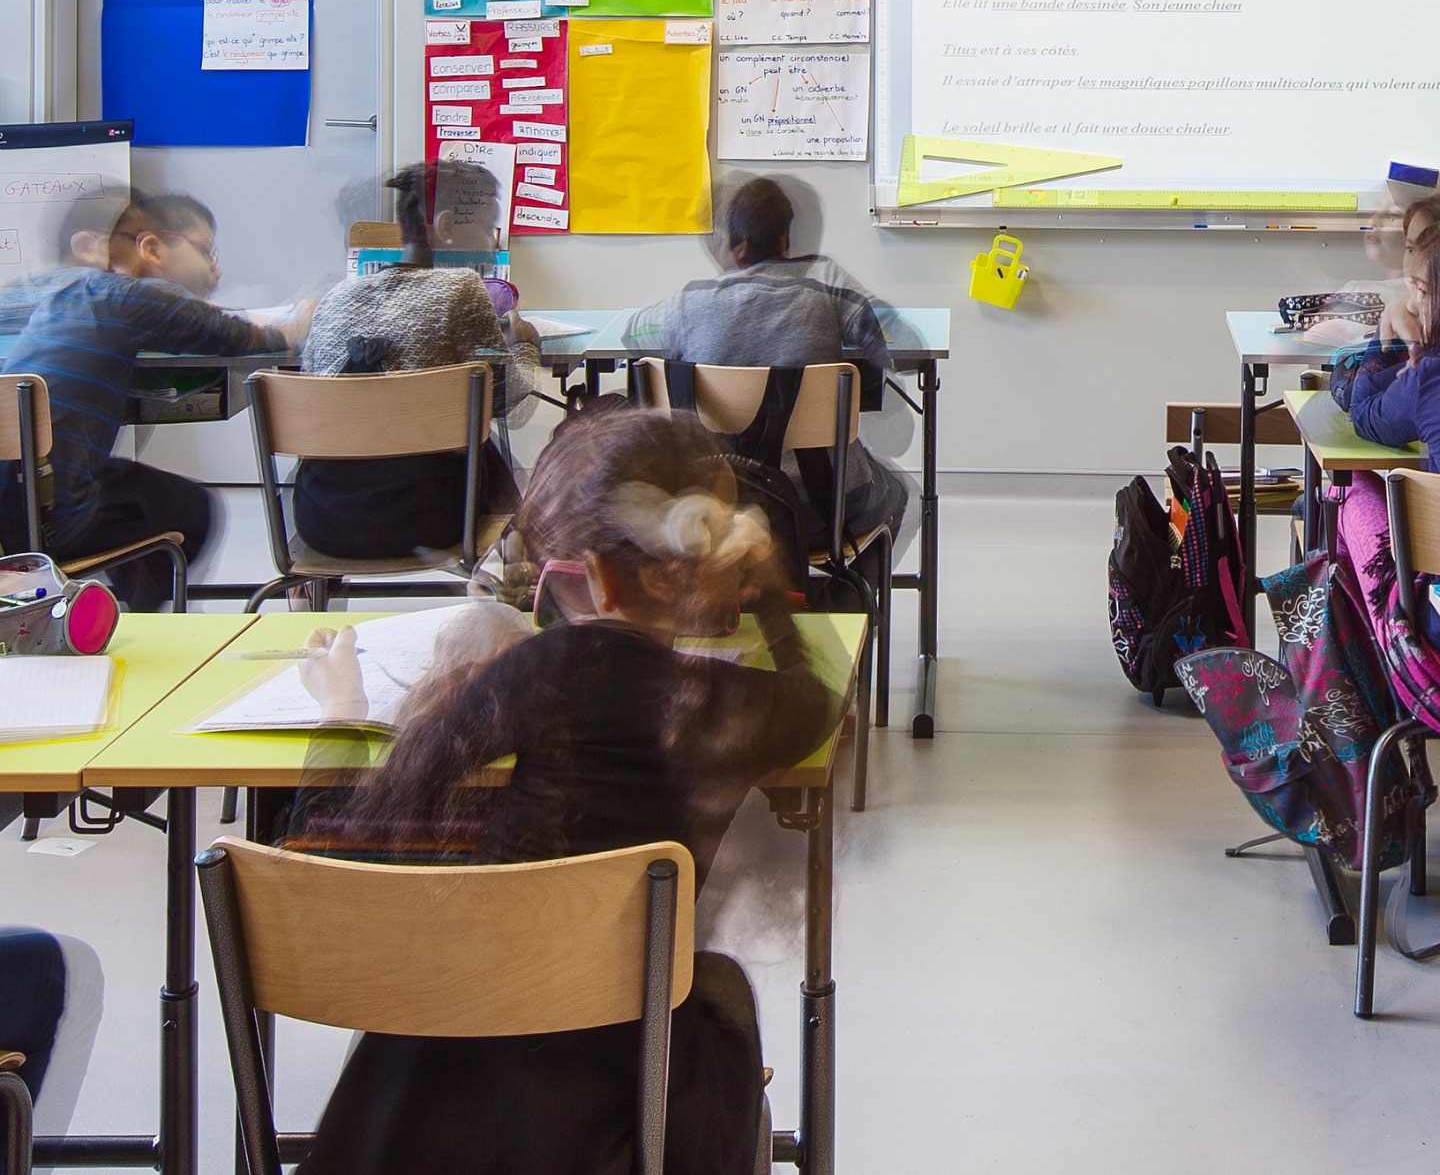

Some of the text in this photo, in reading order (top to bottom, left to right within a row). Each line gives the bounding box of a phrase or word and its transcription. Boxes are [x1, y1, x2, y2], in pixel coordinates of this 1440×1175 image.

[943, 0, 971, 9] Elle
[974, 0, 988, 9] lit
[1021, 0, 1063, 10] bande
[1133, 0, 1161, 11] Son
[1161, 1, 1201, 13] jeune
[1205, 0, 1242, 11] chien
[433, 64, 491, 75] conserver
[433, 84, 488, 94] comparer
[943, 76, 953, 86] Il
[956, 77, 999, 87] essaie
[1002, 76, 1074, 89] d'attraper
[1078, 77, 1097, 88] les
[1100, 77, 1186, 90] magnifiques
[1188, 78, 1253, 90] papillons
[1256, 77, 1343, 90] multicolores
[1346, 79, 1369, 91] qui
[1373, 78, 1415, 90] volent
[943, 122, 960, 134] Le
[963, 122, 1001, 134] soleil
[1004, 122, 1042, 134] brille
[1045, 124, 1058, 134] et
[1062, 123, 1072, 134] il
[1073, 123, 1098, 135] fait
[1103, 125, 1127, 134] une
[1131, 124, 1172, 134] douce
[519, 147, 558, 164] indiquer
[5, 181, 86, 194] GATEAUX
